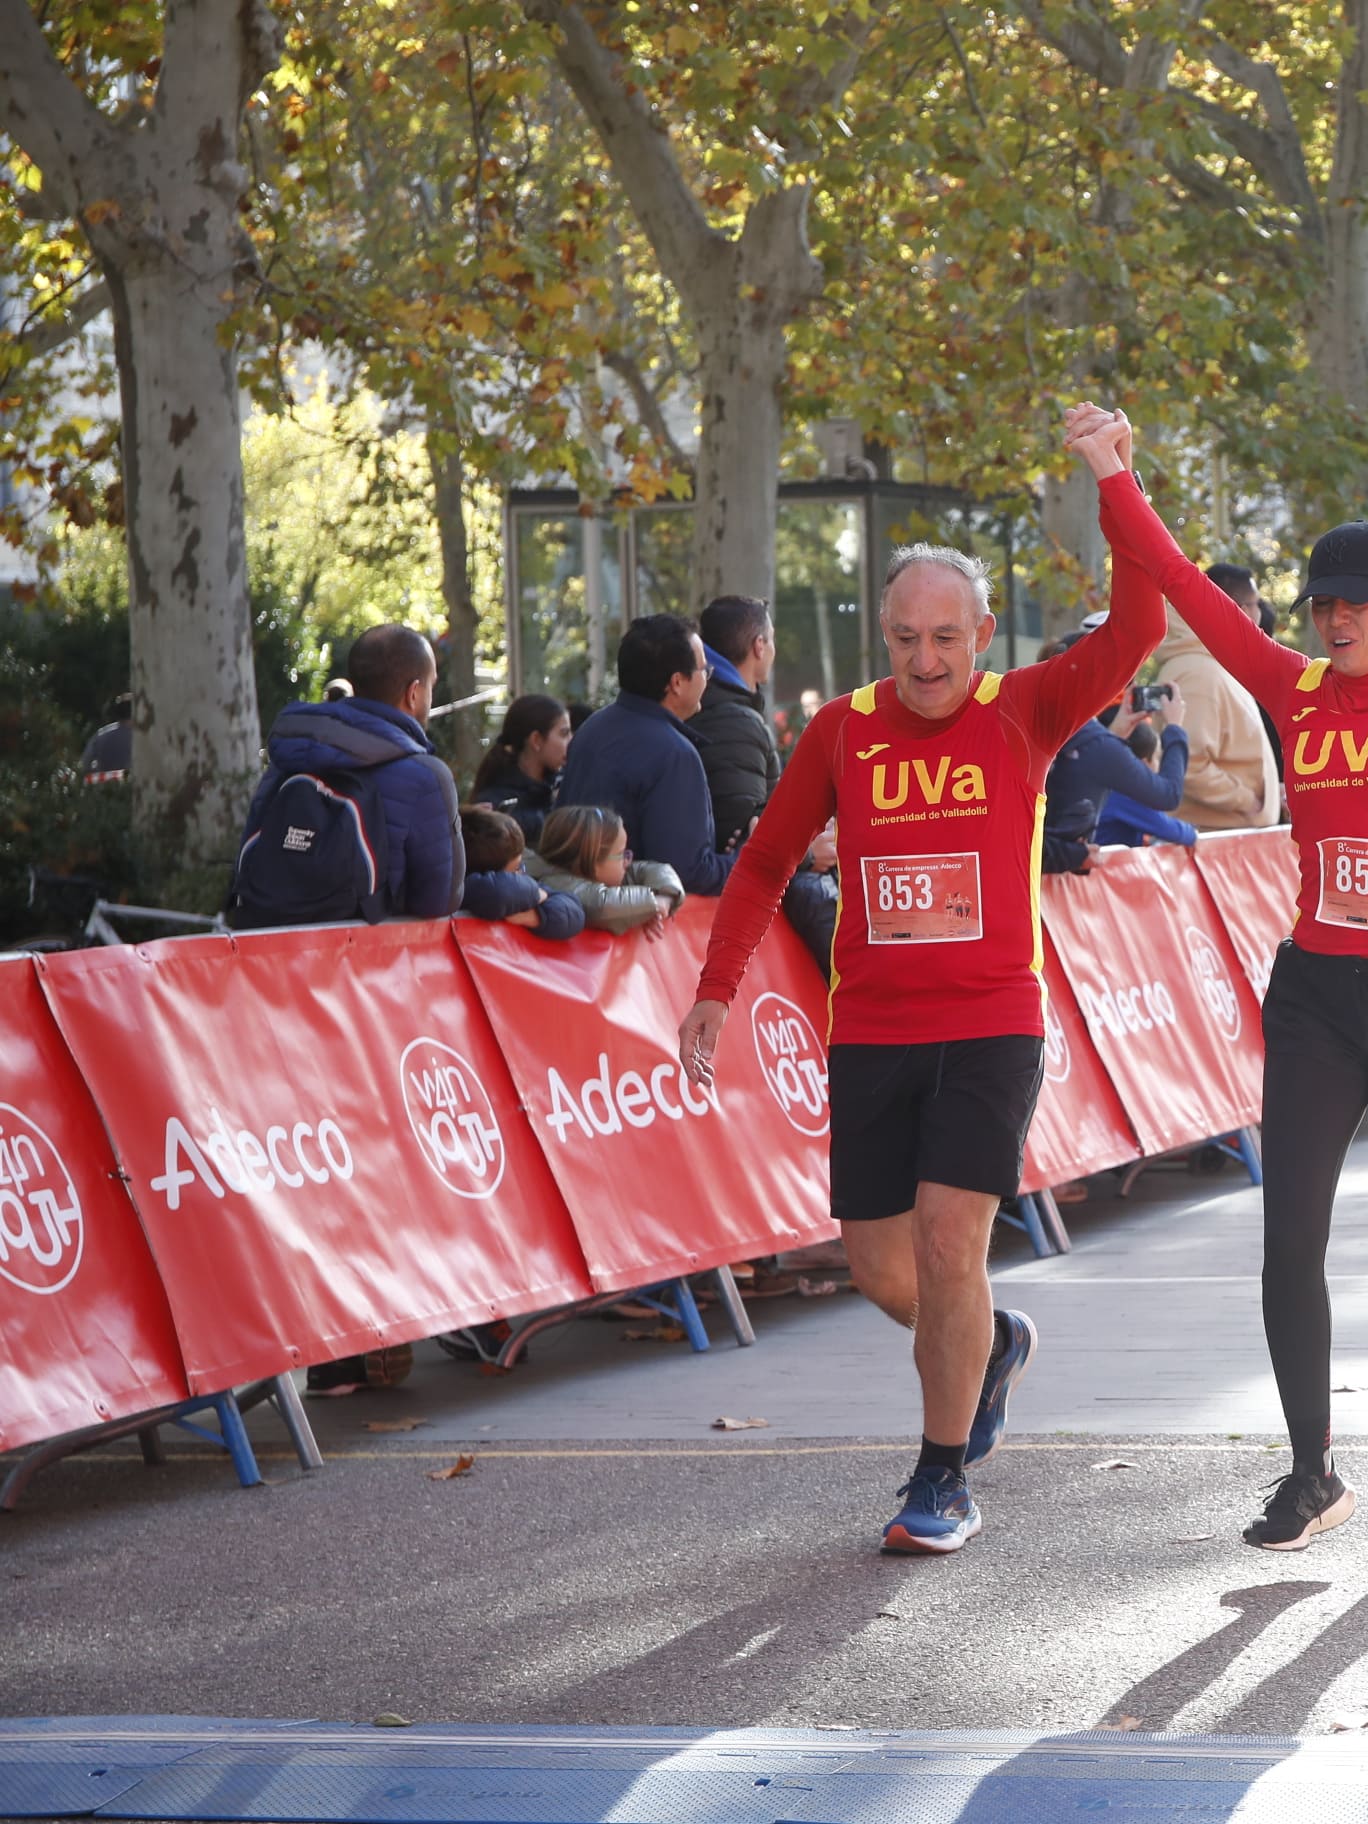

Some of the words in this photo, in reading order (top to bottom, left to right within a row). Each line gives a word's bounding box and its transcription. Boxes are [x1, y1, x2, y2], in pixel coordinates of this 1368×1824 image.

[872, 755, 987, 810] UVa
[1294, 778, 1349, 793] Universidad
[1351, 777, 1364, 787] de
[870, 811, 927, 827] Universidad
[928, 811, 940, 820] de
[941, 806, 988, 818] Valladolid
[878, 873, 934, 911] 853
[1081, 974, 1177, 1038] Adecco
[759, 1009, 809, 1064] win
[410, 1056, 471, 1119] win
[150, 1106, 354, 1211] Adecco
[417, 1110, 500, 1178] YOUTH
[0, 1177, 82, 1267] OUTH
